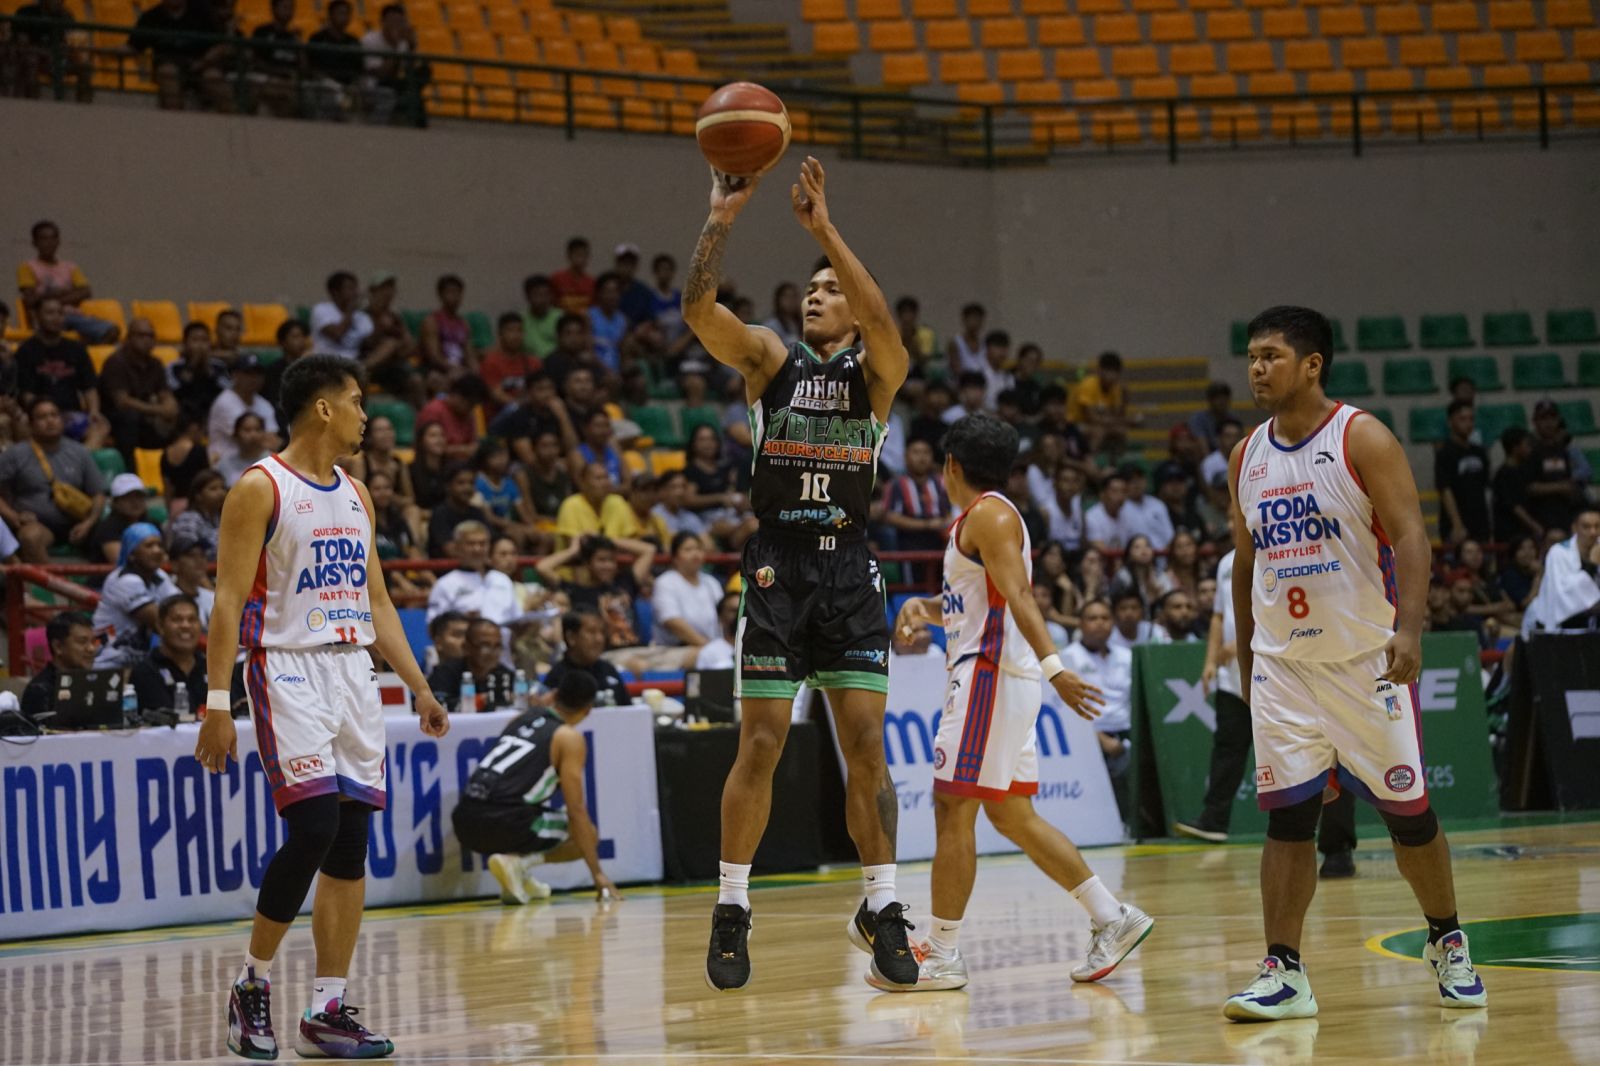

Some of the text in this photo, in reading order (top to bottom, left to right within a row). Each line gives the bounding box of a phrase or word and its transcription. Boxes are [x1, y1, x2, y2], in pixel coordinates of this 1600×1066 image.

[793, 374, 849, 400] BIÑAN
[793, 399, 829, 408] TATAK
[762, 440, 849, 462] MOTORCYCLE
[816, 462, 845, 471] MONSTER
[800, 471, 831, 503] 10
[1261, 481, 1314, 499] QUEZON CITY
[1257, 493, 1322, 525] TODA
[313, 527, 360, 537] QUEZON CITY
[1251, 516, 1342, 551] AKSYON
[310, 538, 366, 564] TODA
[819, 535, 836, 550] 10
[1268, 544, 1322, 561] PARTYLIST
[296, 562, 367, 594] AKSYO
[1277, 560, 1341, 579] ECODRIVE
[1287, 586, 1309, 619] 8
[1289, 627, 1323, 640] Faito
[274, 673, 306, 683] Faito
[1376, 683, 1392, 693] ANTA
[294, 759, 320, 773] J&T
[0, 760, 120, 914] nny
